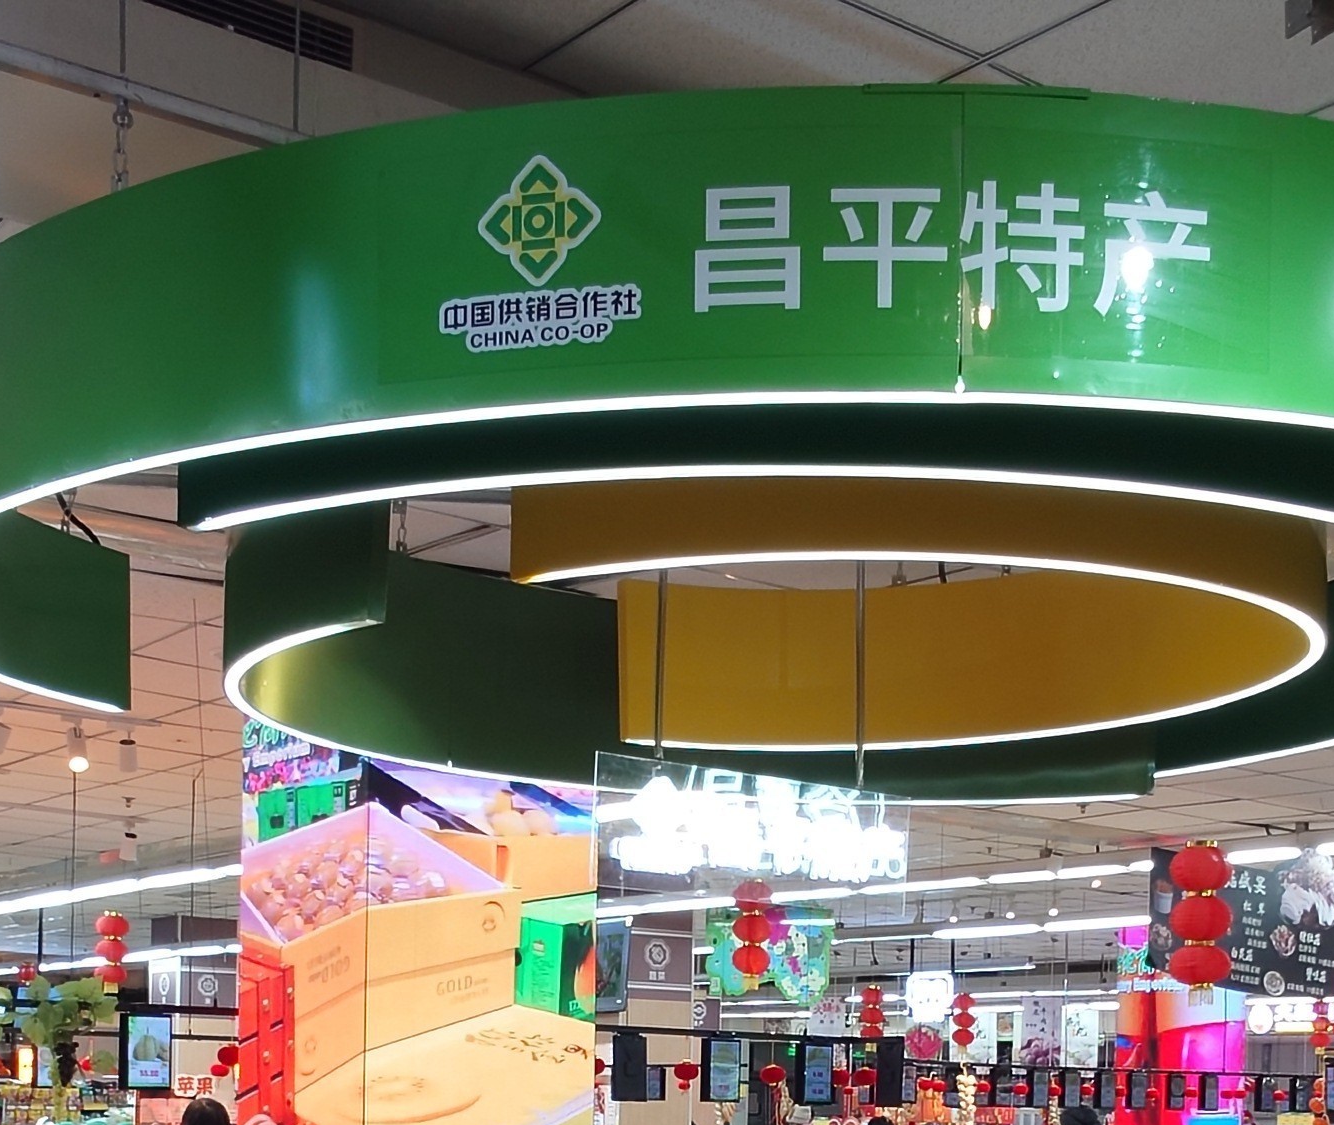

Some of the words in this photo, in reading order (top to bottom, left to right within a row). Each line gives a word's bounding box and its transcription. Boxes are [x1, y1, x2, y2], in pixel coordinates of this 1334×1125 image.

[694, 180, 1210, 316] 昌平特产
[442, 288, 639, 332] 中国供销合作社
[469, 328, 535, 350] CHINA
[540, 321, 609, 345] CO-OP
[436, 976, 474, 997] GOLD
[177, 1077, 215, 1095] 苹果
